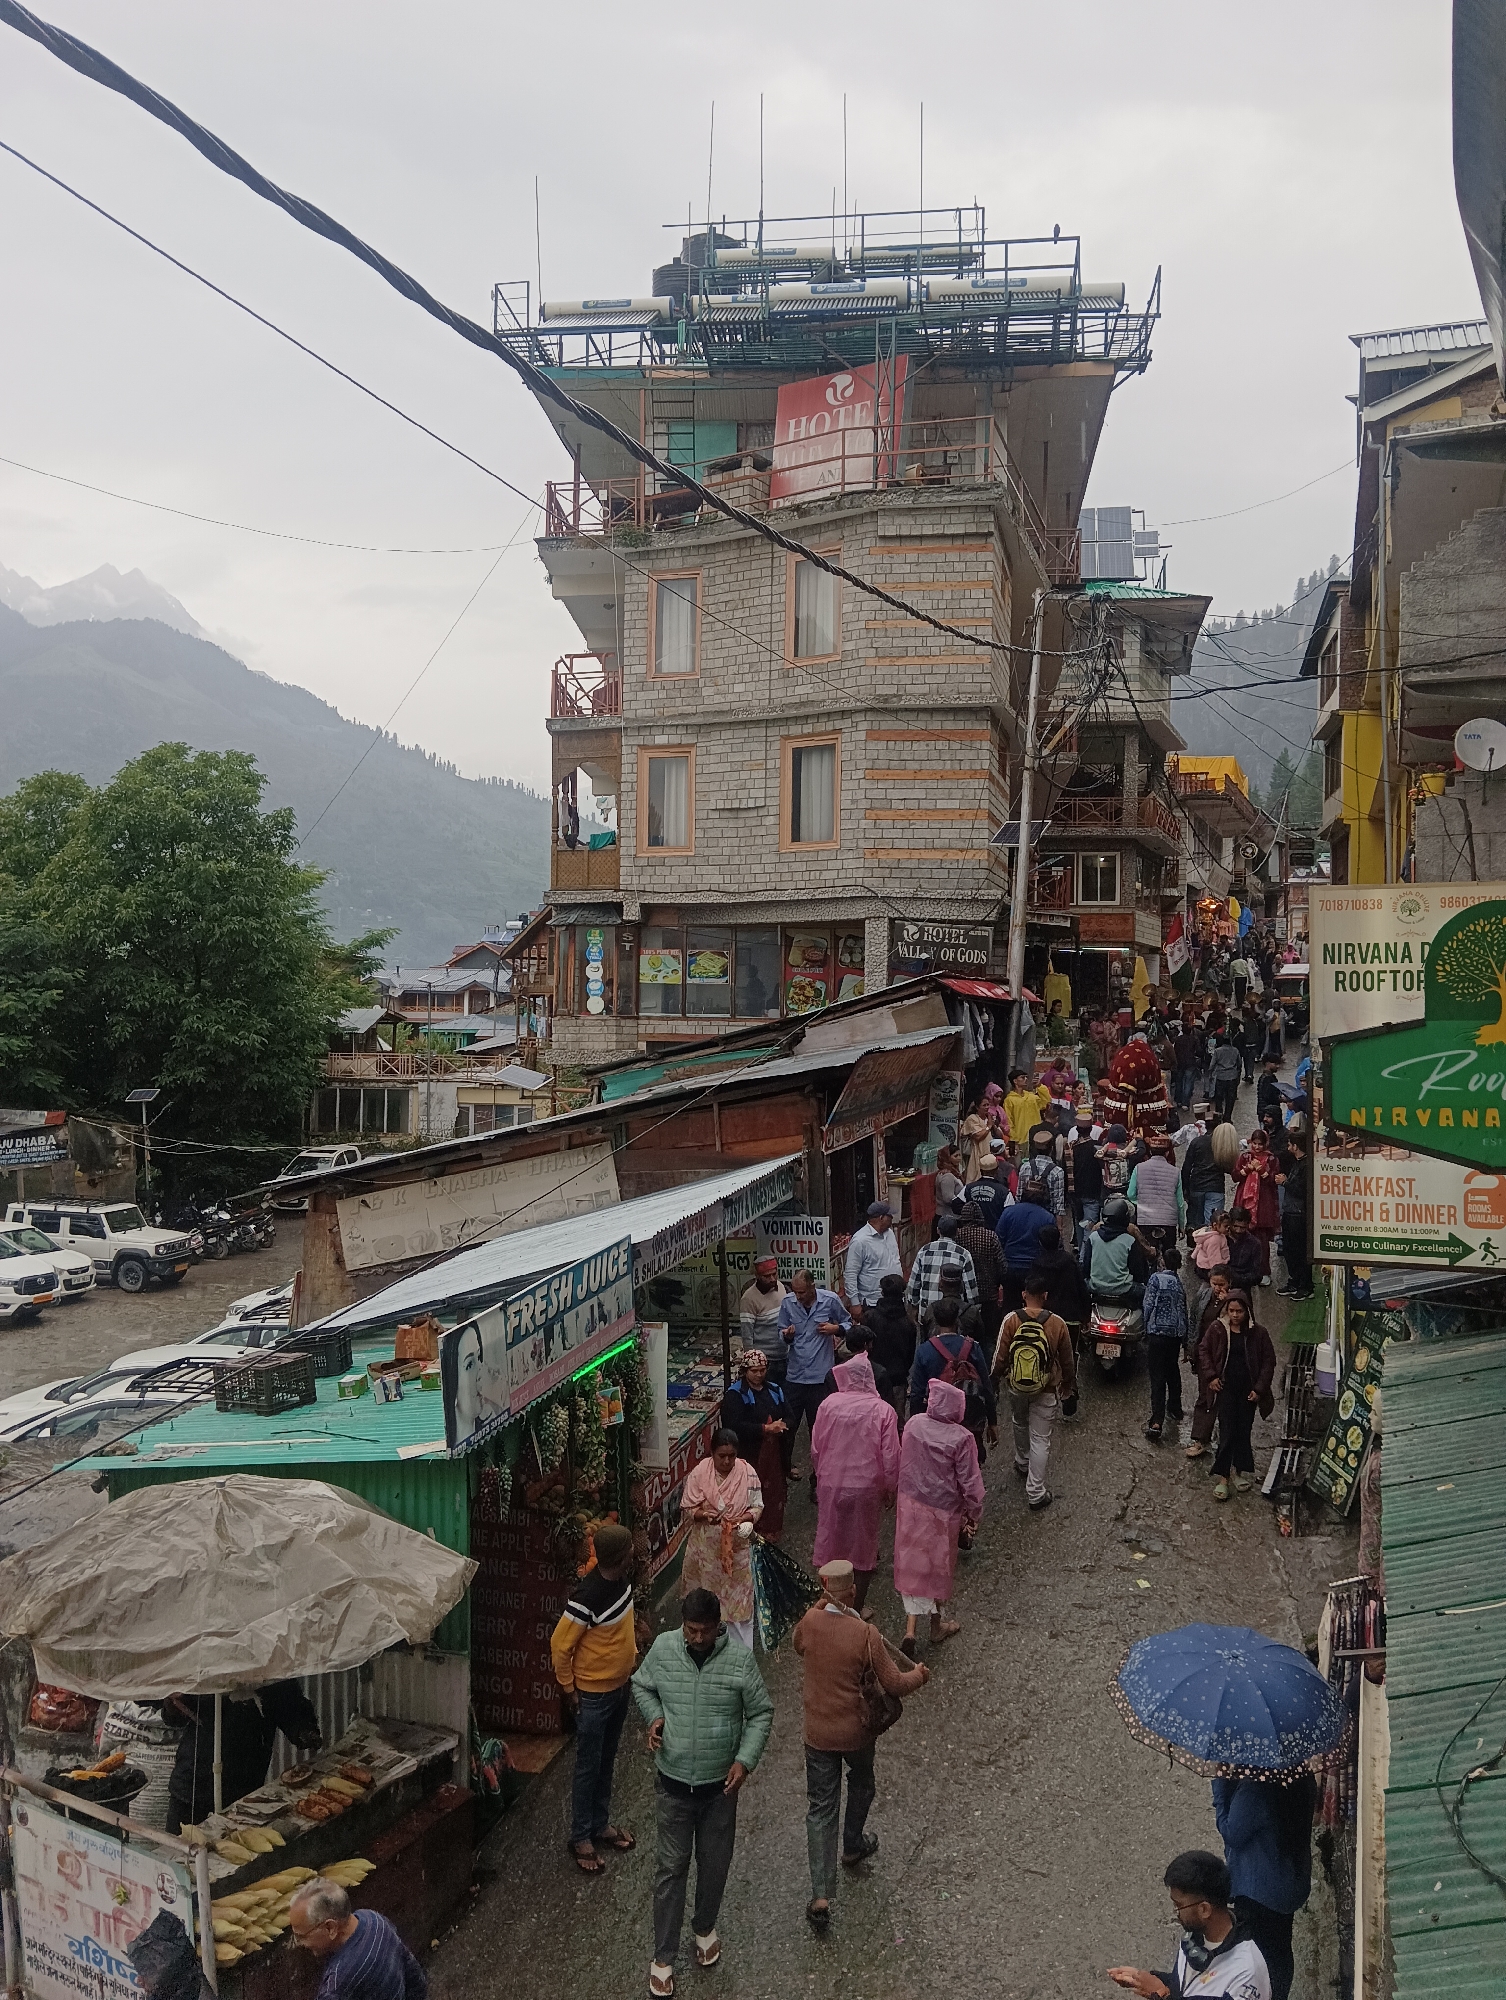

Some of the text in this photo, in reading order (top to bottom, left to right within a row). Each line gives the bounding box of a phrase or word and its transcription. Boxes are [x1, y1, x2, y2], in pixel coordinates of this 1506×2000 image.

[1319, 899, 1383, 911] 7018710838
[923, 926, 968, 944] HOTEL
[940, 948, 956, 962] OF
[957, 948, 988, 964] GODS
[1323, 942, 1413, 964] NIRVANA
[1351, 1107, 1500, 1128] NIRVANA
[15, 1134, 56, 1148] DHABA
[1320, 1164, 1361, 1173] We Serve
[1320, 1174, 1419, 1200] BREAKFAST,
[1320, 1200, 1458, 1226] LUNCH & DINNER
[1468, 1204, 1492, 1213] ROOMS
[1468, 1213, 1505, 1224] AVAILABLE
[762, 1220, 824, 1236] VOMITING
[1346, 1226, 1362, 1234] open
[652, 1232, 669, 1256] 100%
[670, 1222, 686, 1247] PURE
[770, 1240, 819, 1254] (ULTI)
[1325, 1238, 1462, 1254] Step Up to Culinary Excellence!
[634, 1270, 640, 1285] &
[642, 1248, 672, 1282] SHILAJIT
[672, 1232, 705, 1263] AVAILABLE
[705, 1223, 722, 1247] HERE
[794, 1257, 804, 1268] KE
[806, 1258, 825, 1268] LIYE
[506, 1272, 574, 1344] FRESH
[576, 1240, 629, 1300] JUICE
[644, 1446, 692, 1511] TASTY
[694, 1433, 705, 1460] &
[492, 1532, 531, 1552] APPLE
[484, 1704, 524, 1726] FRUIT
